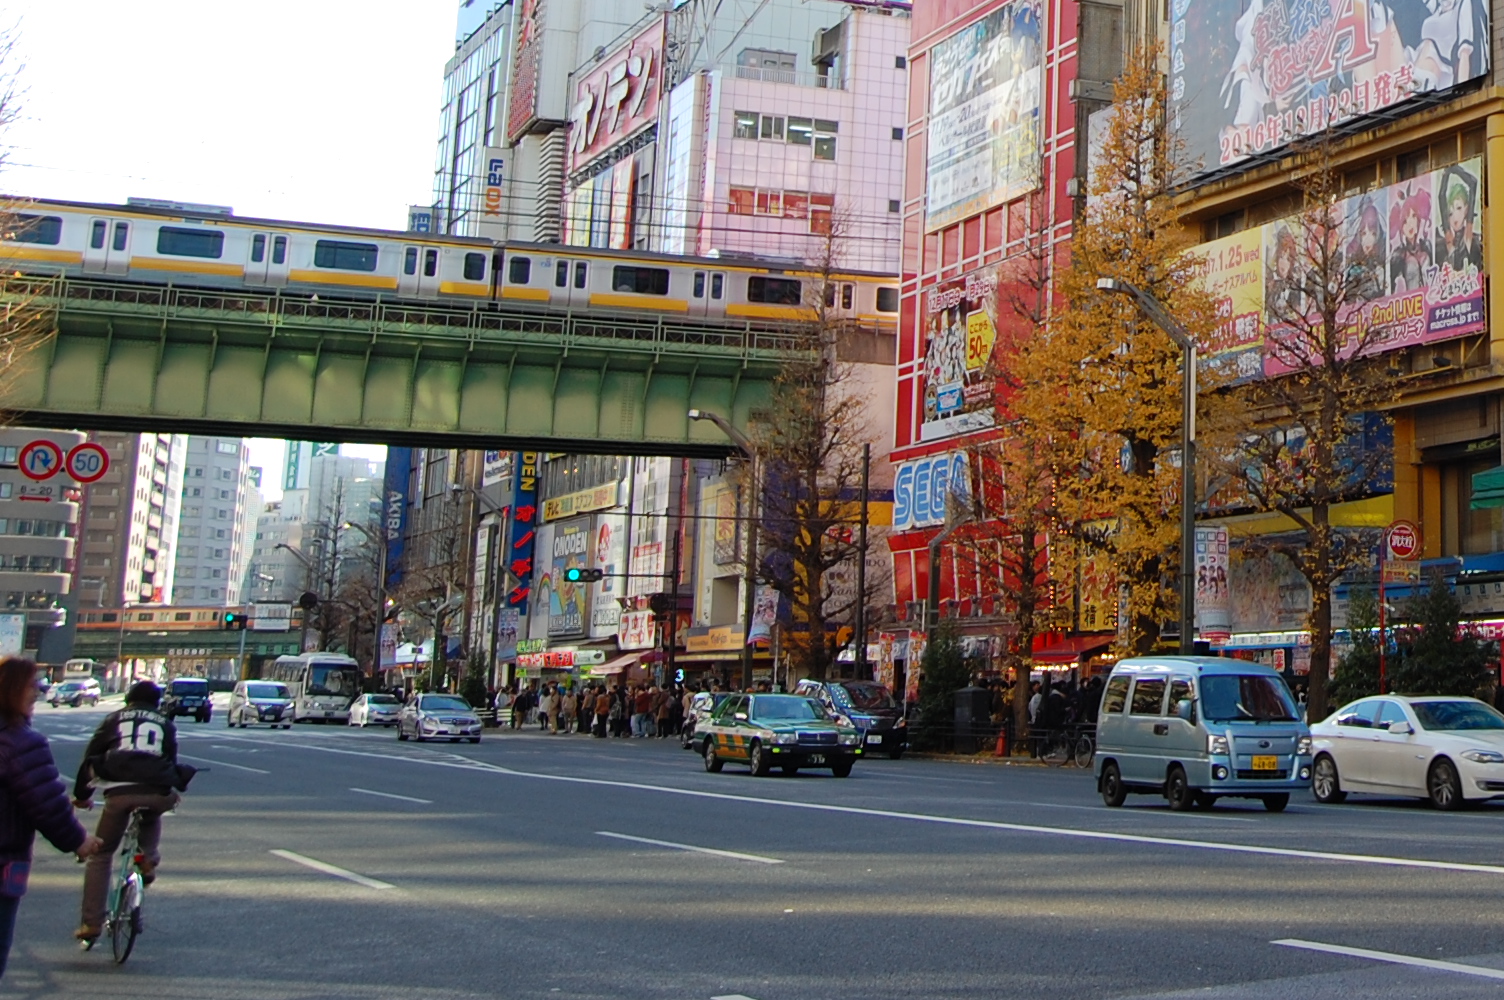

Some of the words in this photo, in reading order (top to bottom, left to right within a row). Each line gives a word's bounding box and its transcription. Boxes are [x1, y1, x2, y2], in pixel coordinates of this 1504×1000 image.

[1244, 246, 1260, 263] wed
[1371, 303, 1393, 325] 2nd
[1395, 295, 1424, 321] LIVE
[75, 453, 100, 473] 50
[893, 450, 973, 531] SEGA
[387, 490, 404, 541] AKIBA
[554, 531, 588, 558] ONODEN
[118, 720, 165, 756] 10
